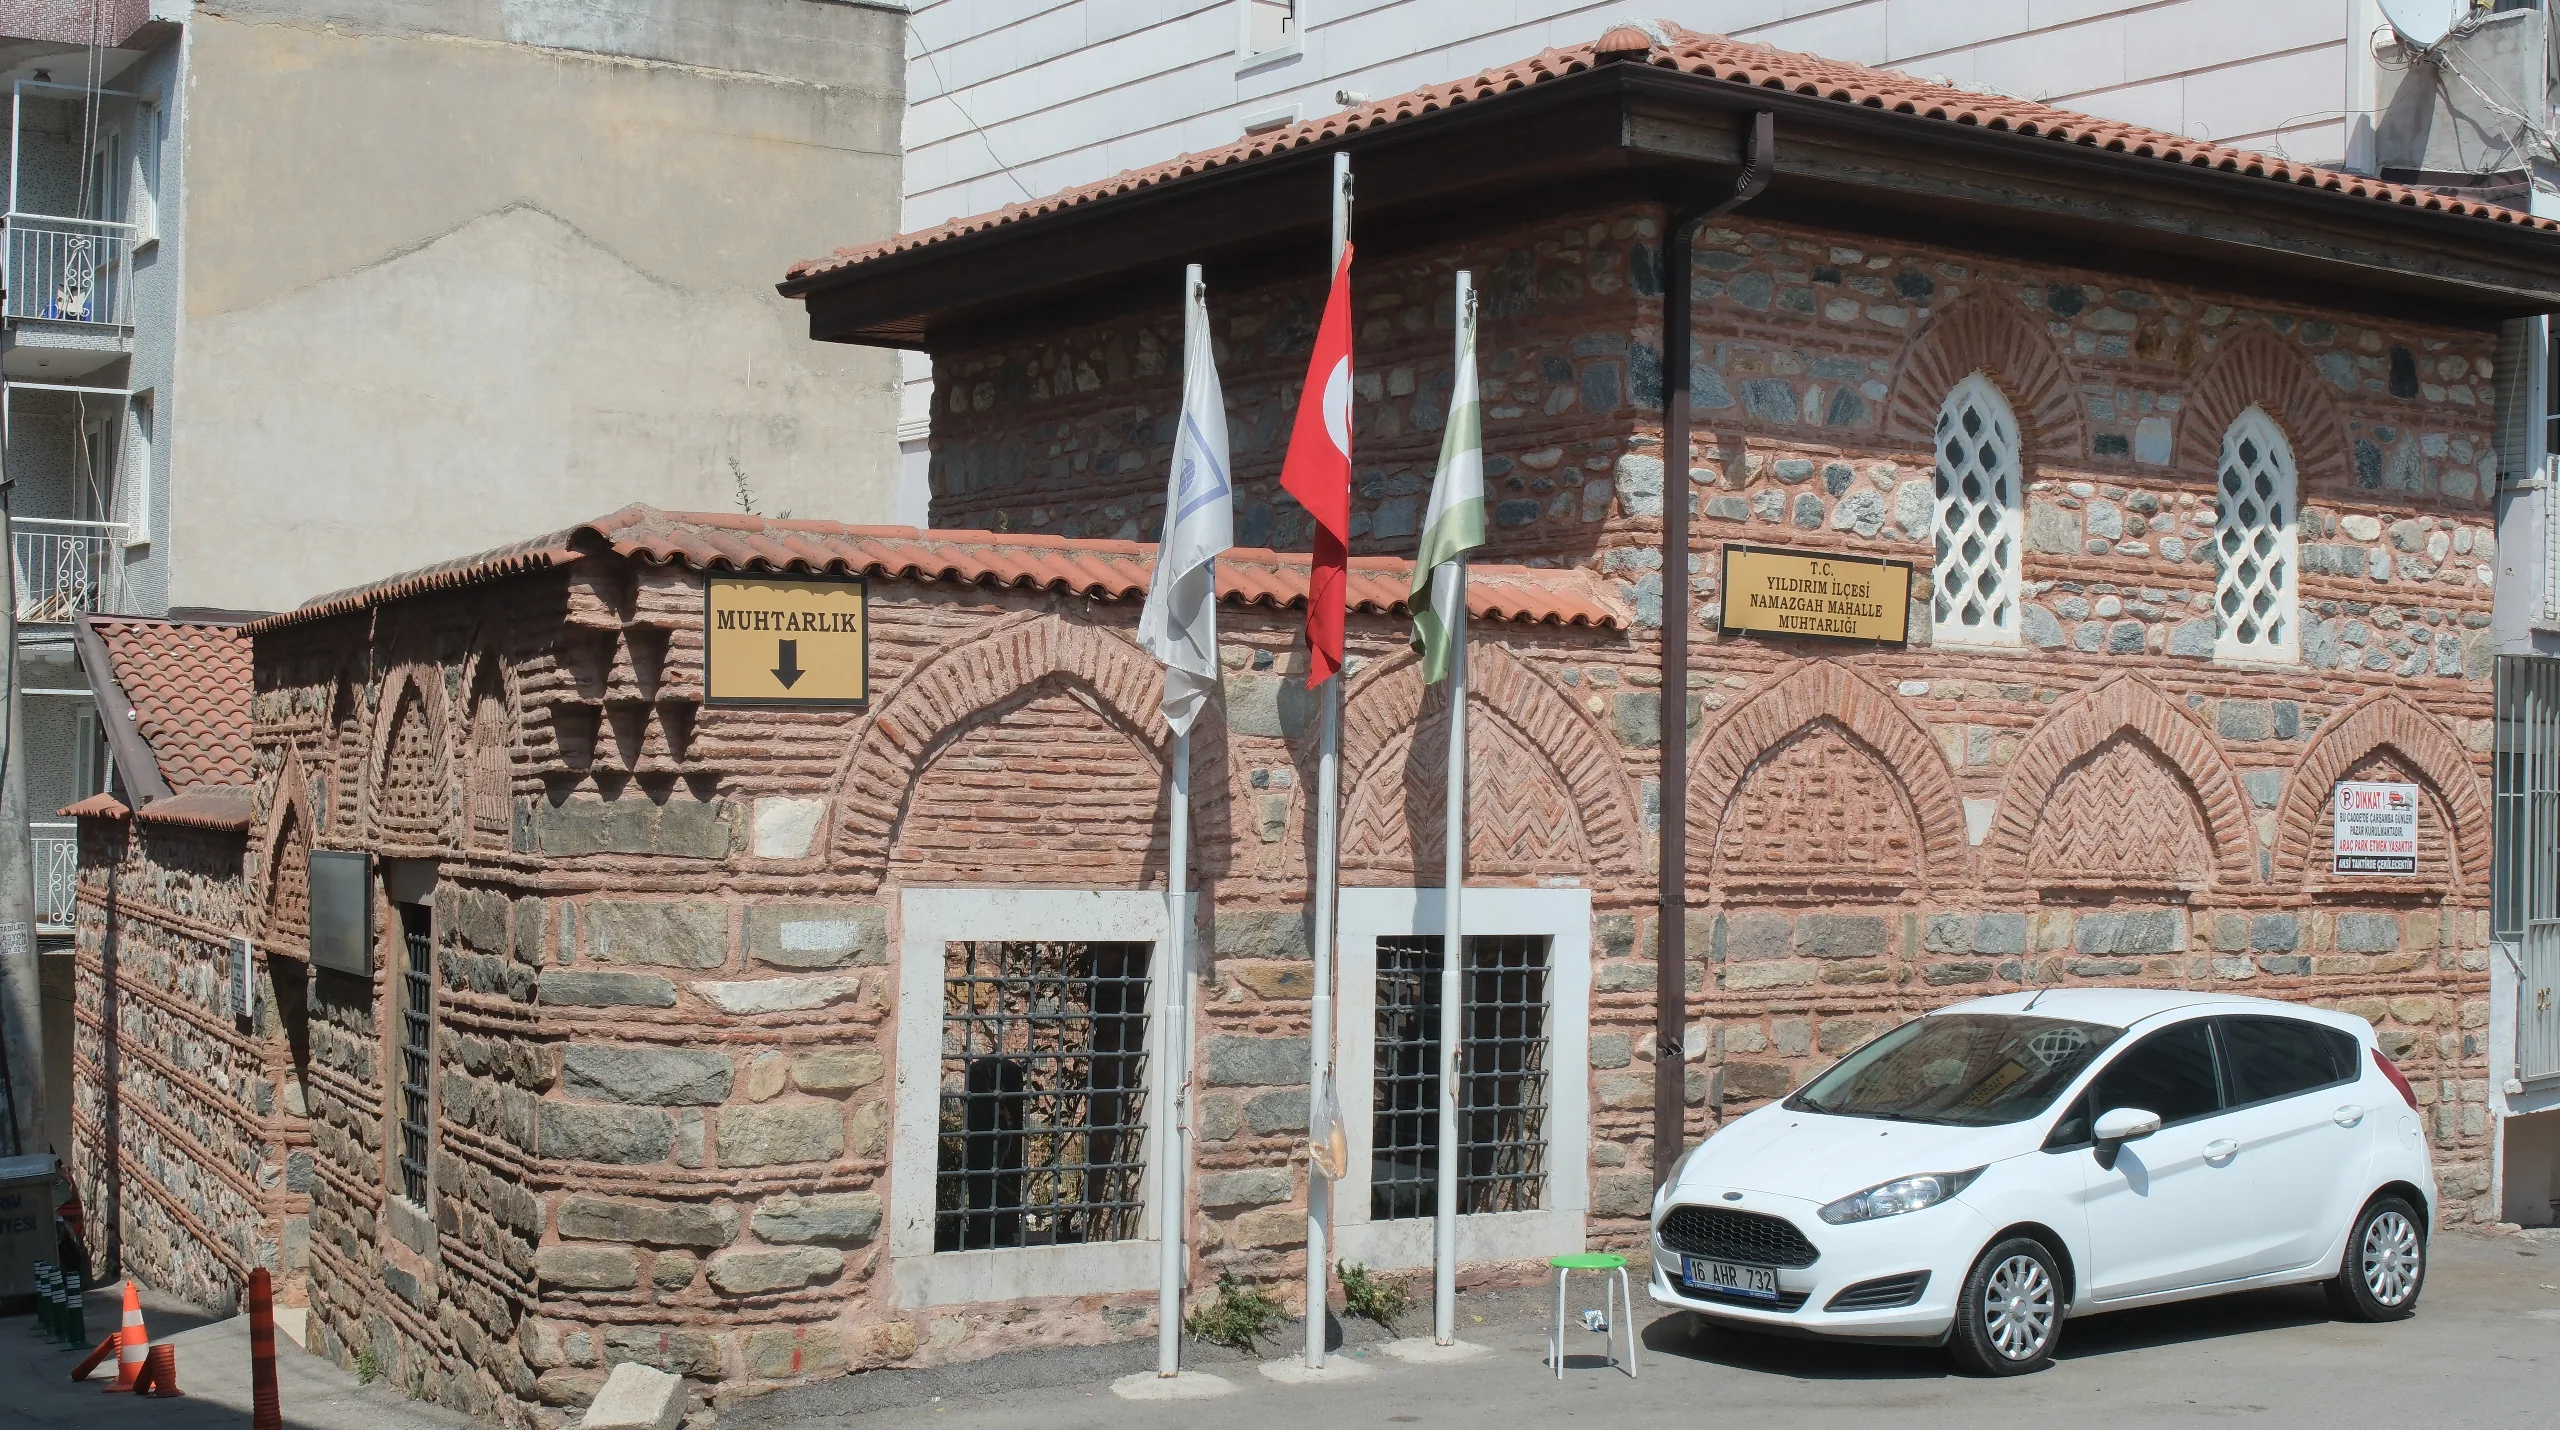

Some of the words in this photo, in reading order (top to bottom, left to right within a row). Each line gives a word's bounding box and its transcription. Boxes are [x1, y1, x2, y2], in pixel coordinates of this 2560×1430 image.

[1810, 561, 1834, 576] T.C.
[1767, 576, 1828, 595] YILDIRIM
[1831, 577, 1871, 600] İLÇESİ
[1750, 593, 1823, 613] NAMAZGAH
[1827, 600, 1883, 618] MAHALLE
[716, 609, 857, 633] MUHTARLIK
[1778, 614, 1857, 634] MUHTARLIĞI
[2350, 826, 2364, 836] PAZAR
[2339, 840, 2353, 854] ARAÇ
[2355, 840, 2368, 851] PARK
[2370, 840, 2387, 852] ETMEK
[2389, 841, 2413, 852] YASAKTIR
[1691, 1261, 1706, 1281] 16
[1713, 1263, 1738, 1287] AHR
[1745, 1268, 1773, 1291] 732
